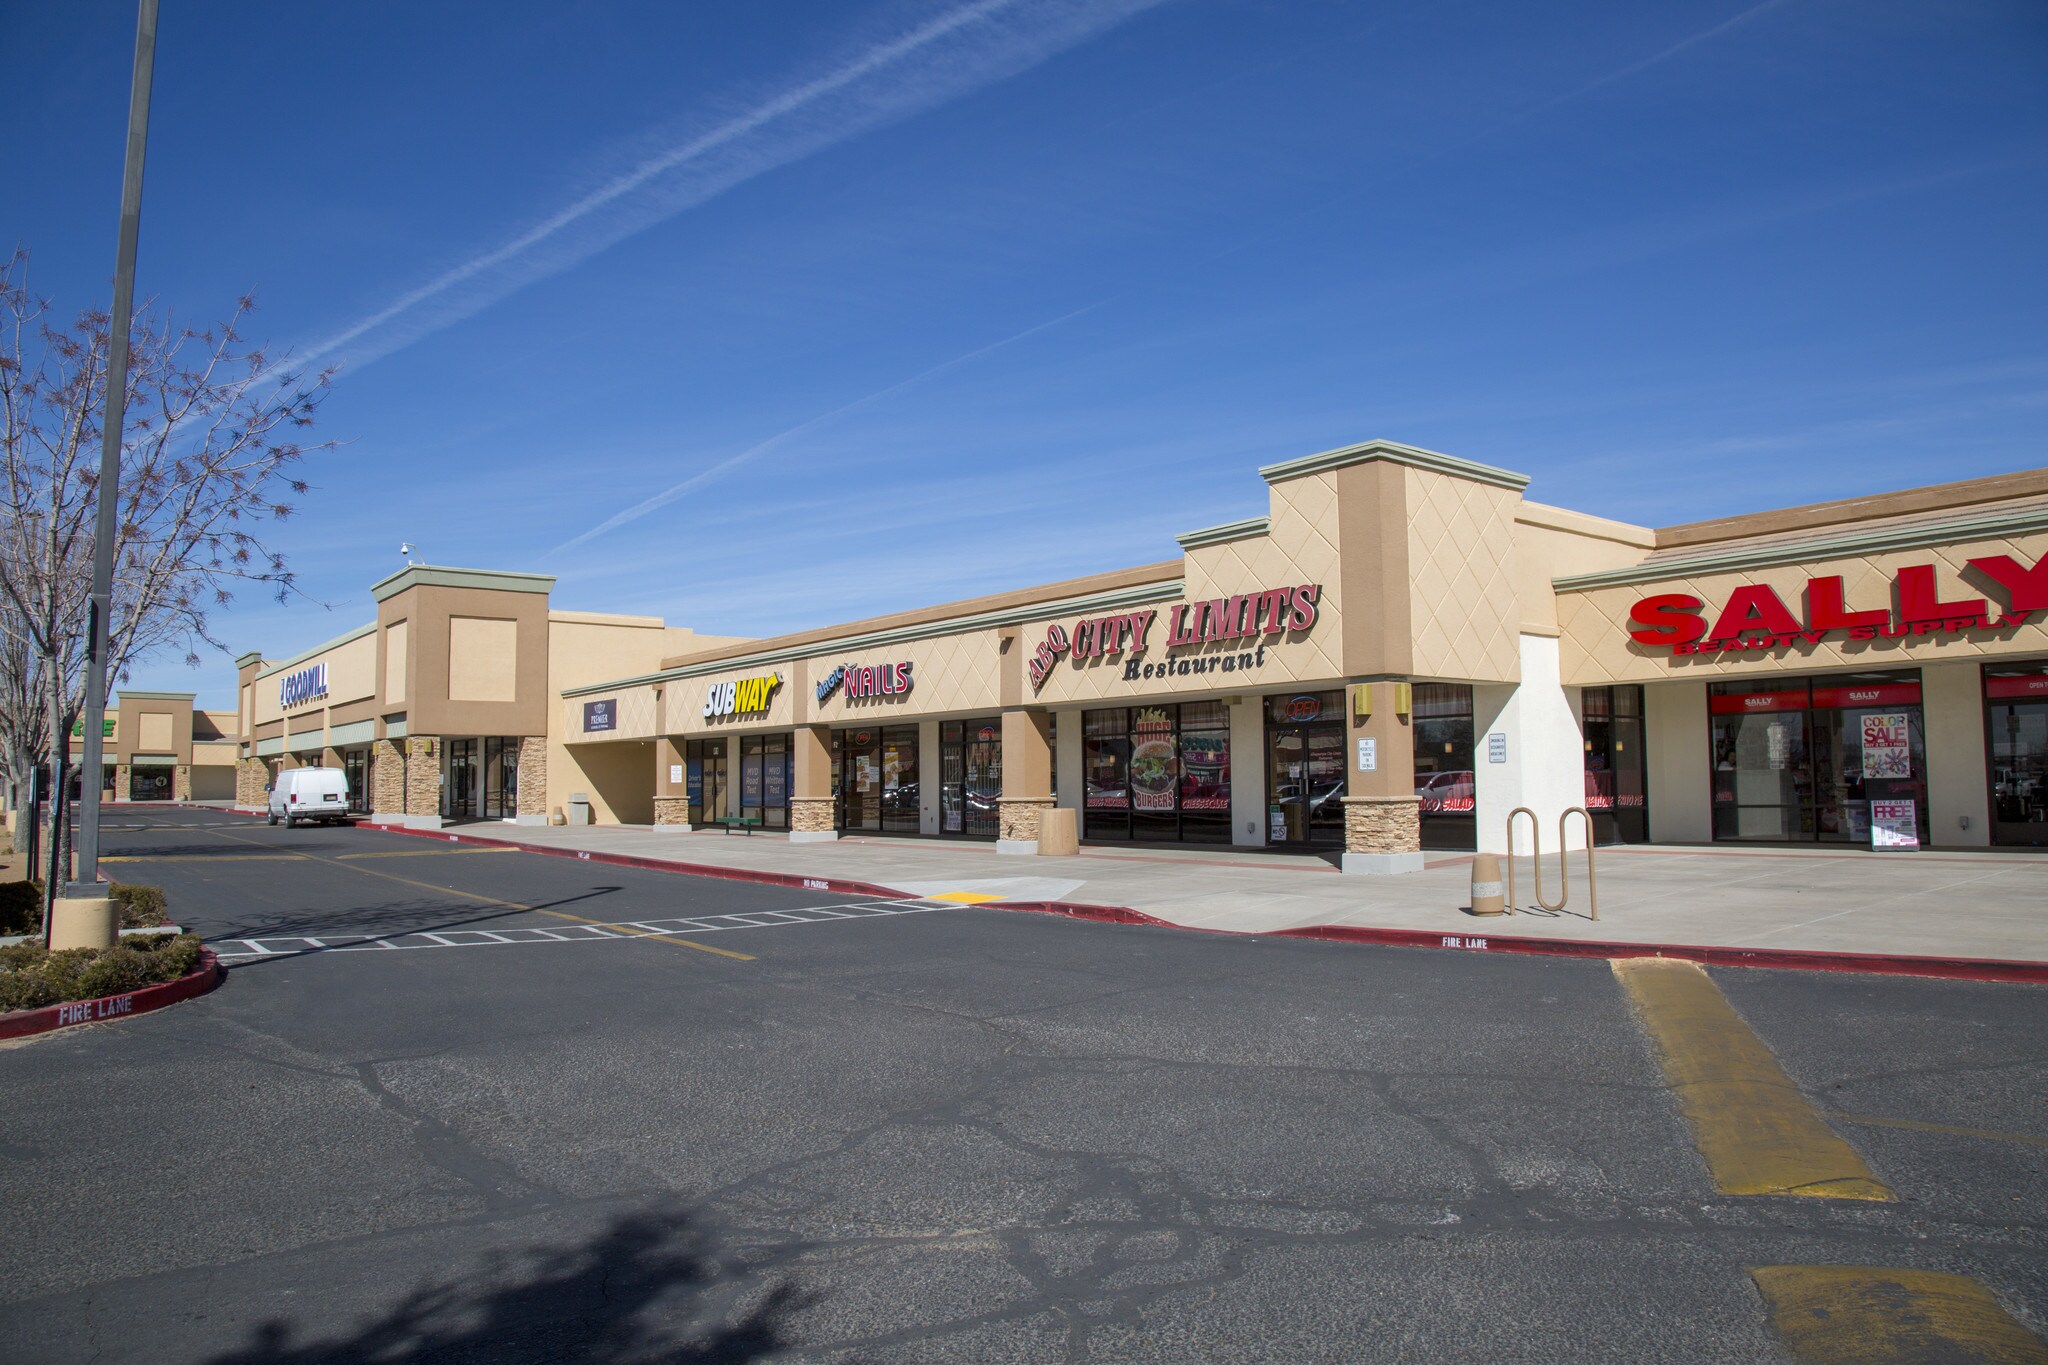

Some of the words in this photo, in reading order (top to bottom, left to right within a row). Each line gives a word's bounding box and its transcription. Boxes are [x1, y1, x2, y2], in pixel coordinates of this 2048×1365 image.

[1630, 552, 2048, 645] SALLY
[1028, 624, 1070, 689] ABQ
[1071, 610, 1153, 660] CITY
[1166, 584, 1318, 647] LIMITS
[1673, 631, 1825, 656] BEAUTY
[1848, 611, 2031, 641] SUPPLY
[1122, 644, 1265, 681] Restaurant
[285, 662, 328, 705] GOODWILL
[815, 665, 845, 701] MAGIC
[843, 662, 914, 699] NAILS
[702, 672, 779, 717] SUBWAY
[1744, 697, 1772, 706] SALLY
[1849, 691, 1880, 700] SALLY
[1286, 701, 1320, 717] OPEN
[1863, 716, 1905, 727] COLOR
[1136, 721, 1171, 746] HUGE
[1864, 727, 1906, 743] SALE
[1135, 790, 1174, 808] BURGERS
[1182, 798, 1229, 810] CHEESECAKE
[1443, 798, 1475, 812] SALAD
[1873, 805, 1912, 818] FREE
[1442, 936, 1461, 947] FIRE
[1465, 937, 1488, 949] LANE
[59, 1002, 92, 1026] FIRE
[98, 996, 132, 1017] LANE
